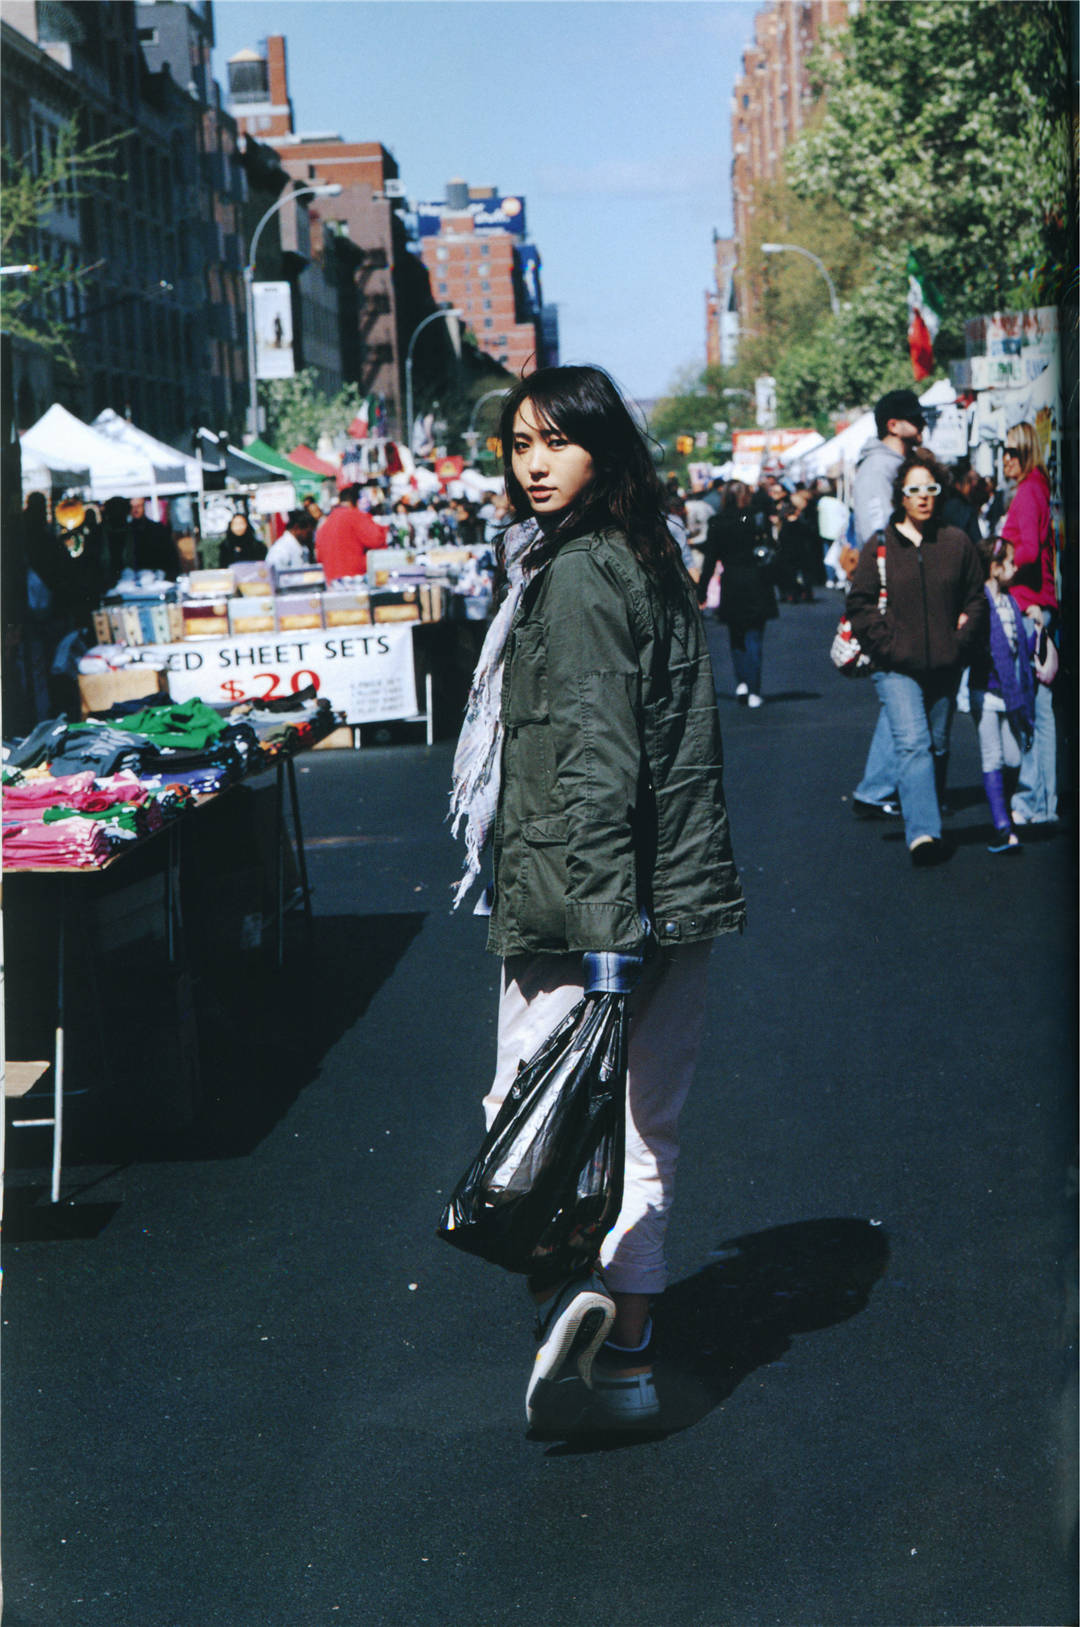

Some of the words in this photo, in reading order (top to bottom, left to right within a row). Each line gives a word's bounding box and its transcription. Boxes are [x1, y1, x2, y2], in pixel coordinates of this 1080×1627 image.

[218, 642, 310, 668] SHEET
[324, 635, 390, 659] SETS
[219, 669, 321, 702] $20
